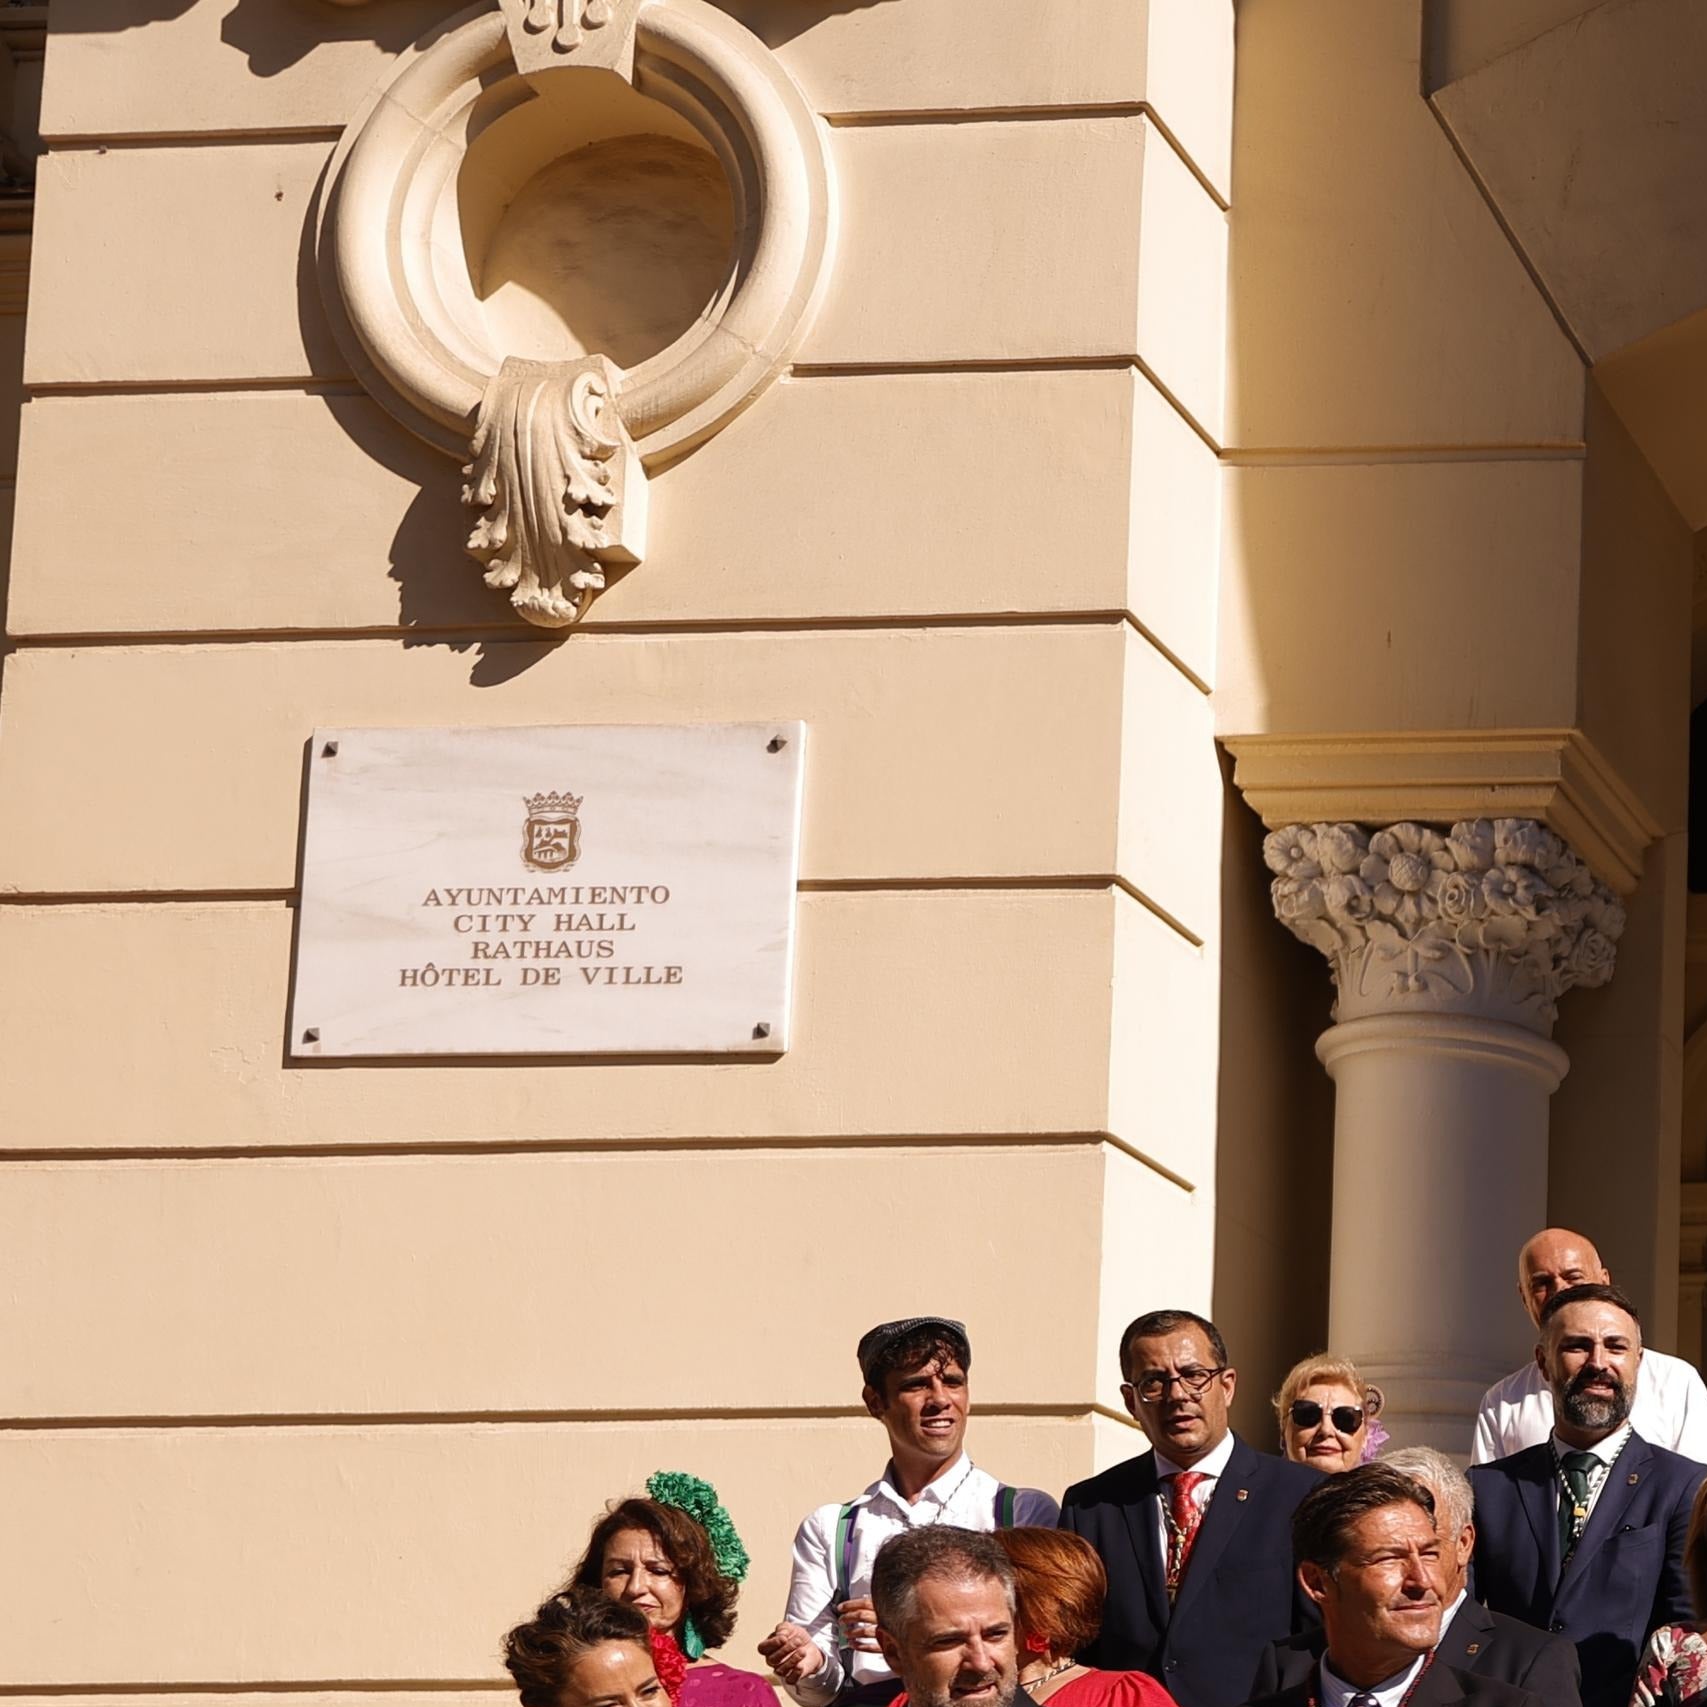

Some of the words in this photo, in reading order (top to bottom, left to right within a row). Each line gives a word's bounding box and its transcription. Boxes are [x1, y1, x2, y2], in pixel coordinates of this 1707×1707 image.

[422, 885, 671, 908] AYUNTAMIENTO
[453, 914, 537, 933] CITY
[553, 912, 637, 932] HALL
[471, 940, 615, 960] RATHAUS
[399, 962, 502, 988] HÔTEL
[519, 966, 561, 986] DE
[580, 965, 684, 986] VILLE
